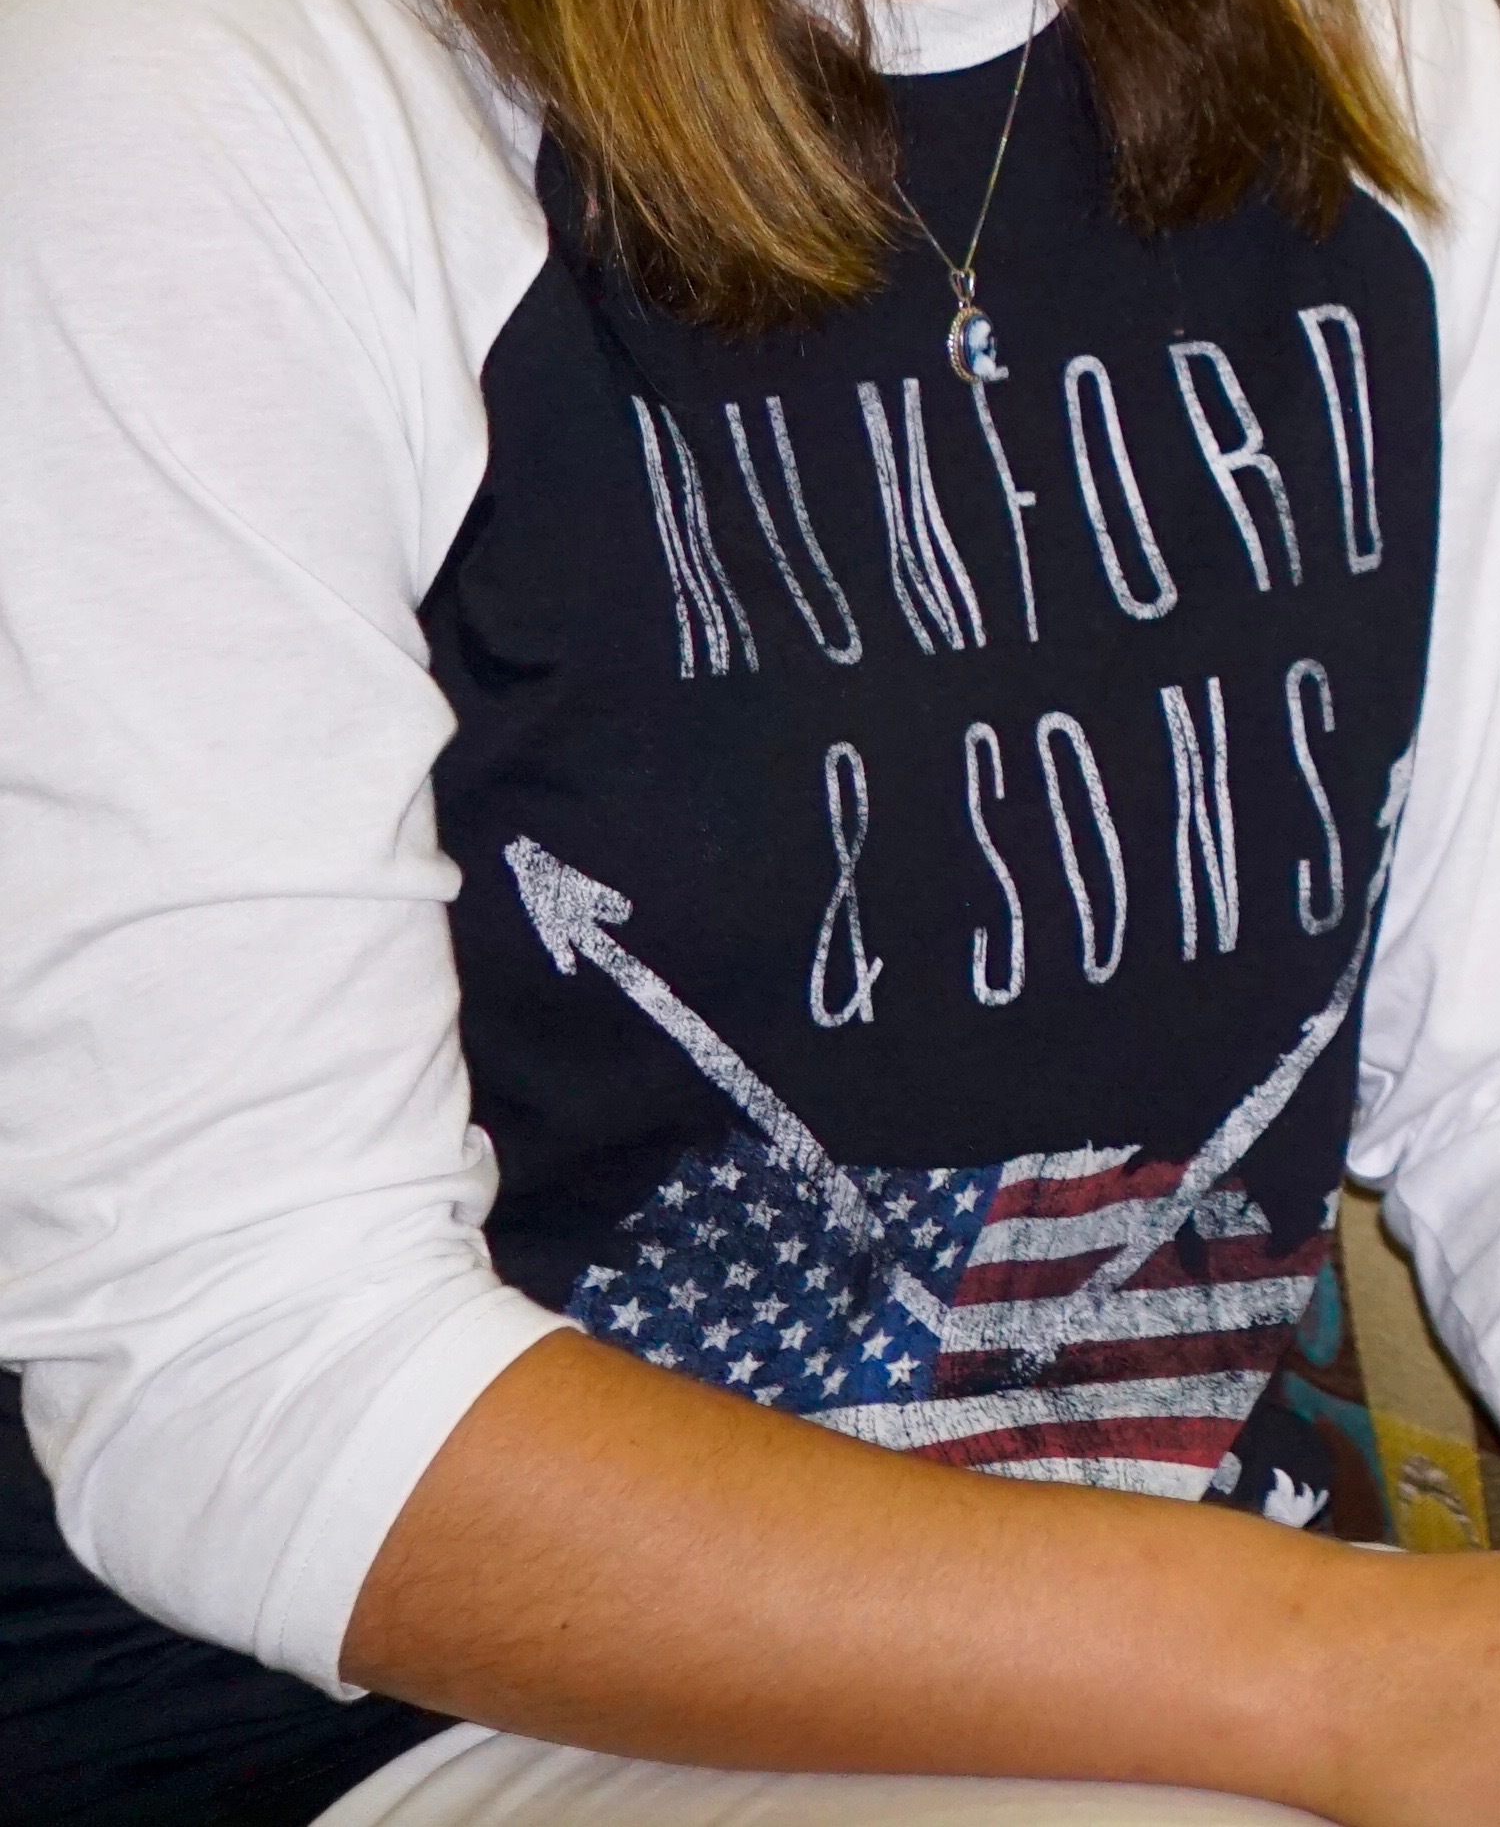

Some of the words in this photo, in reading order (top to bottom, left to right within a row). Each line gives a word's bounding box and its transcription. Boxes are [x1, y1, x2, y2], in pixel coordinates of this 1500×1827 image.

[631, 304, 1383, 678] MUMFORD
[810, 741, 883, 1028] &
[964, 659, 1344, 1007] SONS
